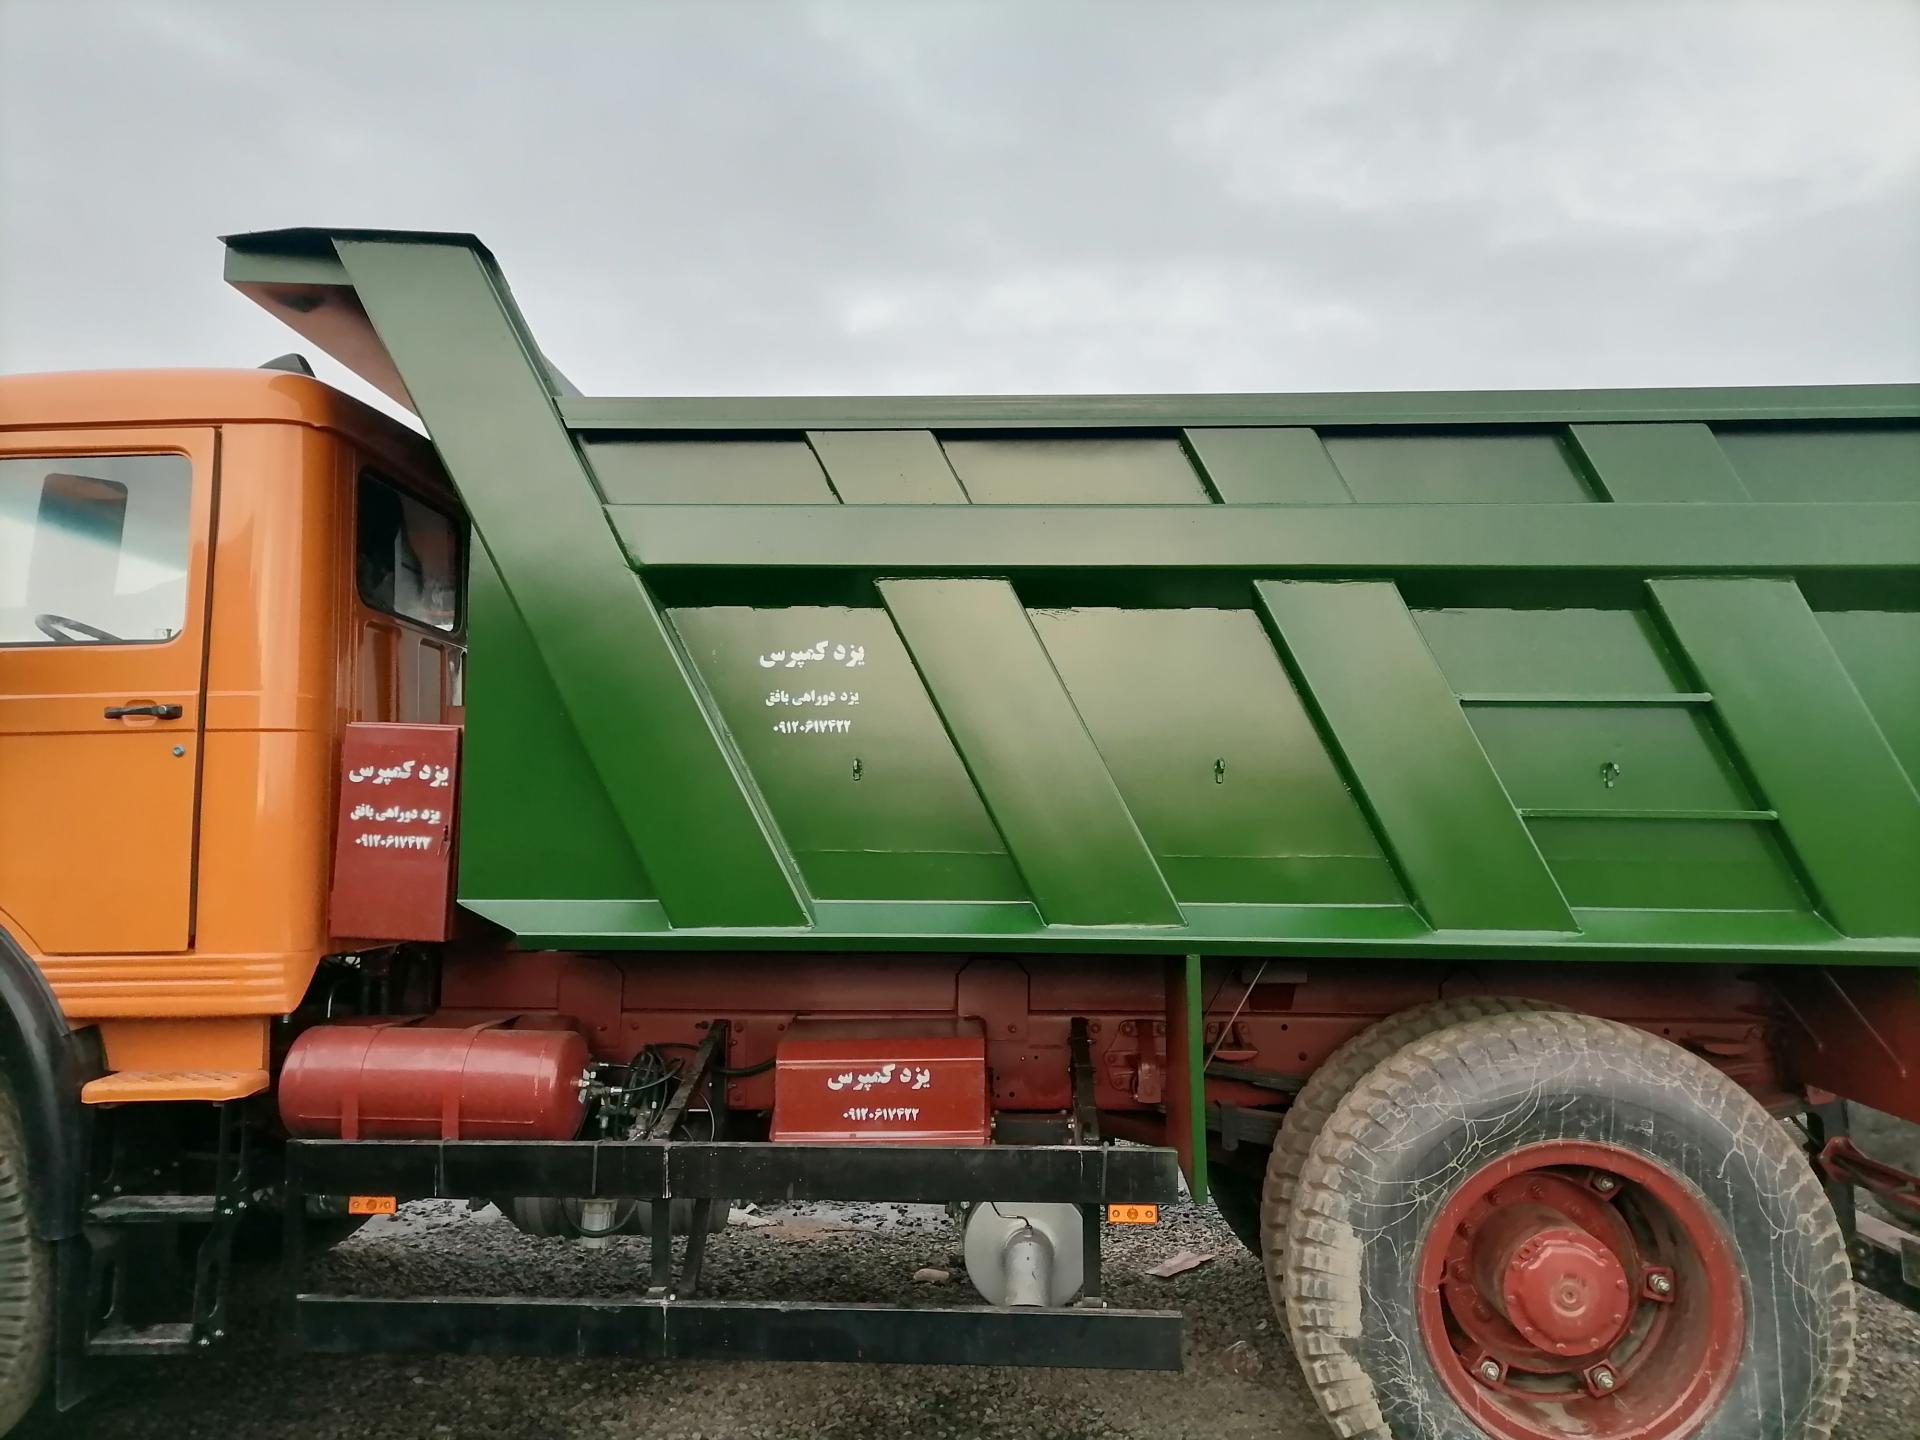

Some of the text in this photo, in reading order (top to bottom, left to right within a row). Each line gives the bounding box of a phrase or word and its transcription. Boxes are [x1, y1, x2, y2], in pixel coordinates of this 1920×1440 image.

[833, 644, 865, 667] یزد
[765, 690, 789, 706] بافق
[841, 691, 860, 705] یزد
[419, 765, 449, 787] یزد
[350, 803, 374, 820] بافق
[421, 809, 441, 824] یزد
[900, 1067, 931, 1089] یزد
